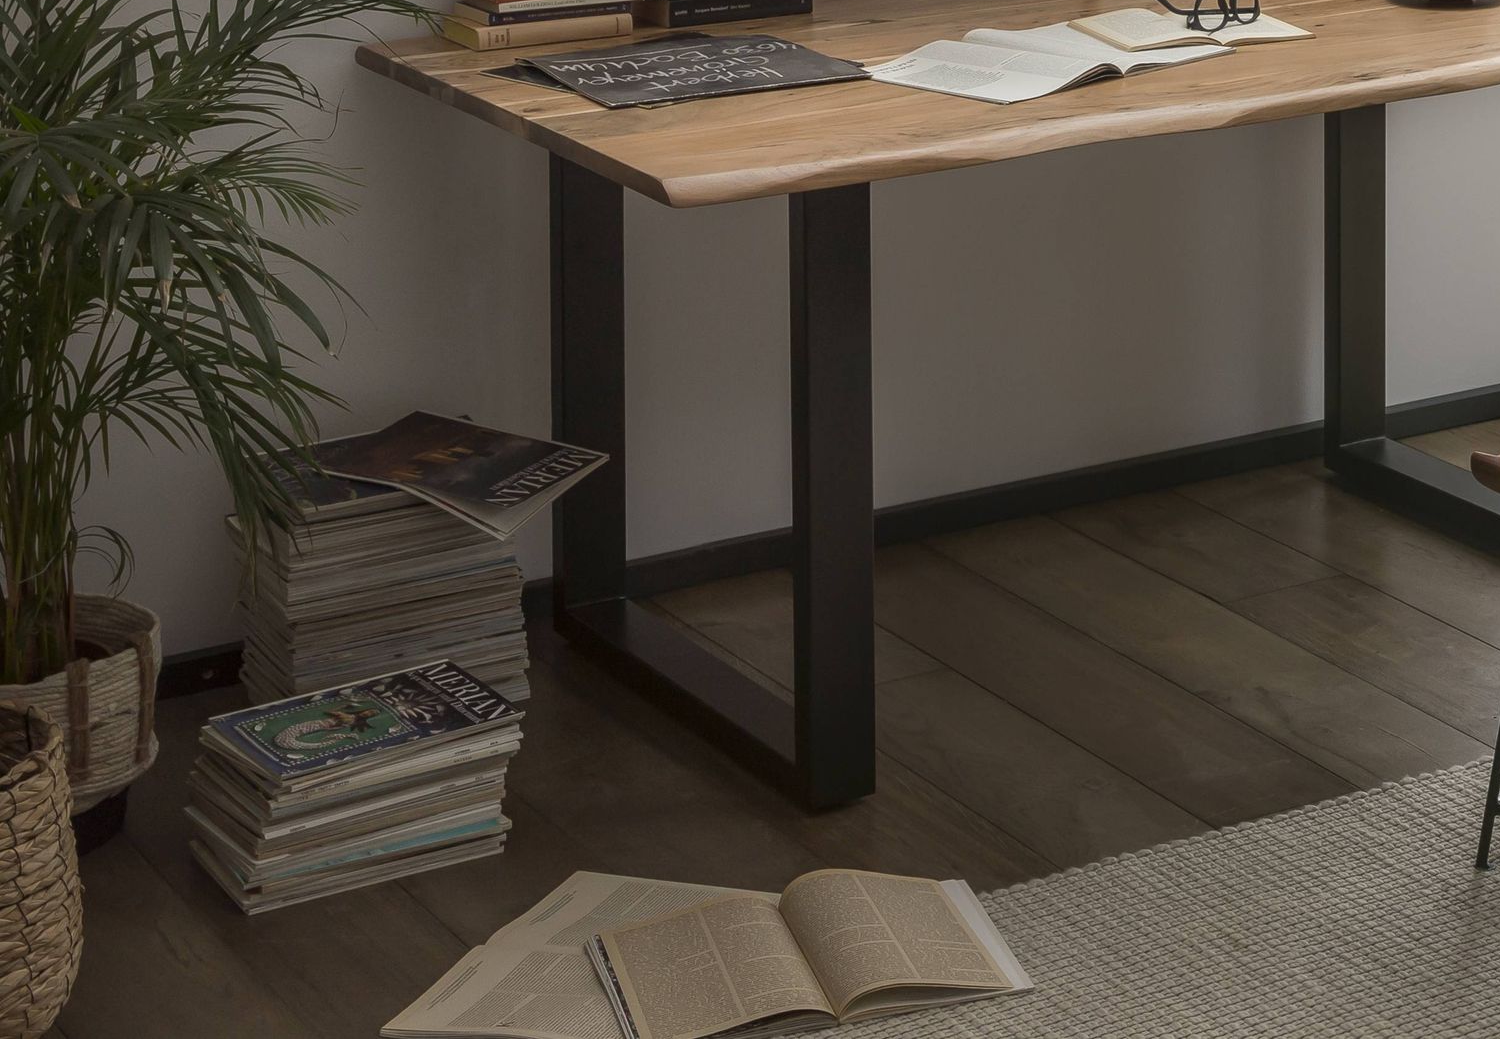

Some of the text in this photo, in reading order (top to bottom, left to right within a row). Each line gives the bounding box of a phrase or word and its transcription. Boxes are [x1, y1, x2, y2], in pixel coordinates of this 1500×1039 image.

[578, 55, 770, 86] Grönemeyer
[646, 65, 783, 92] Herbert
[484, 450, 598, 507] MERIAN
[418, 663, 516, 720] MERIAN
